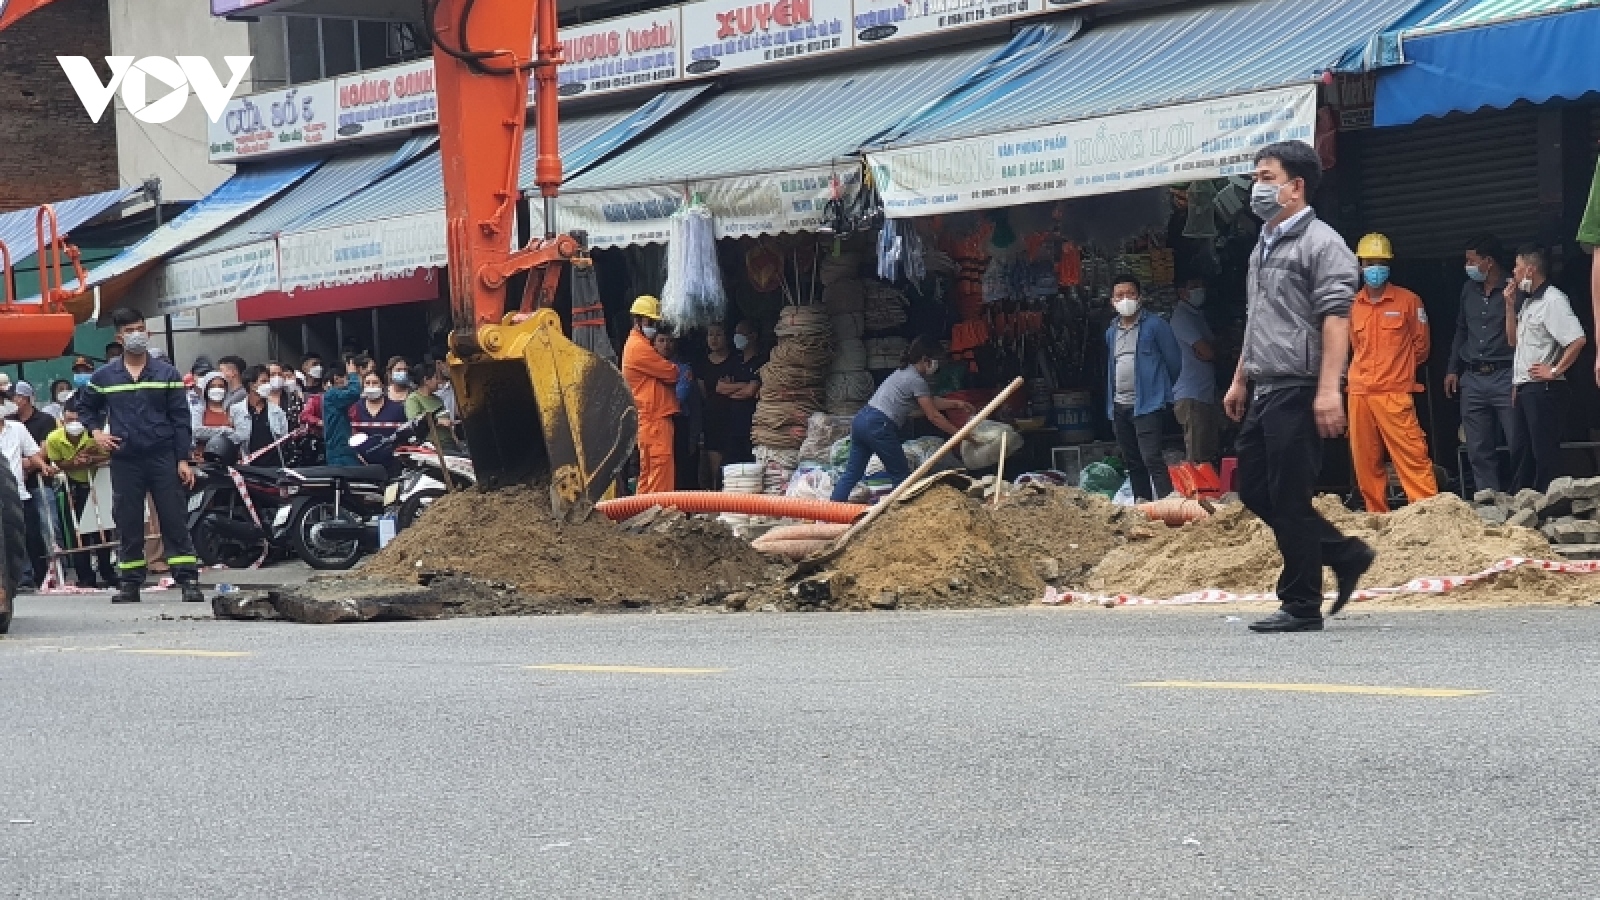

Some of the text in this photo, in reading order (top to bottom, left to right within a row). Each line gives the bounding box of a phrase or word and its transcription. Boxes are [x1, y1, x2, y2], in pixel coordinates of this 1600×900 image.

[225, 96, 266, 135] CỬA
[271, 88, 298, 128] SỐ
[301, 95, 314, 123] 5
[1015, 138, 1042, 157] PHÒNG
[1043, 131, 1067, 153] PHẨM
[937, 140, 995, 187] LONG
[1001, 164, 1017, 179] BAO
[1029, 158, 1044, 175] CÁC
[1047, 157, 1065, 175] LOẠI
